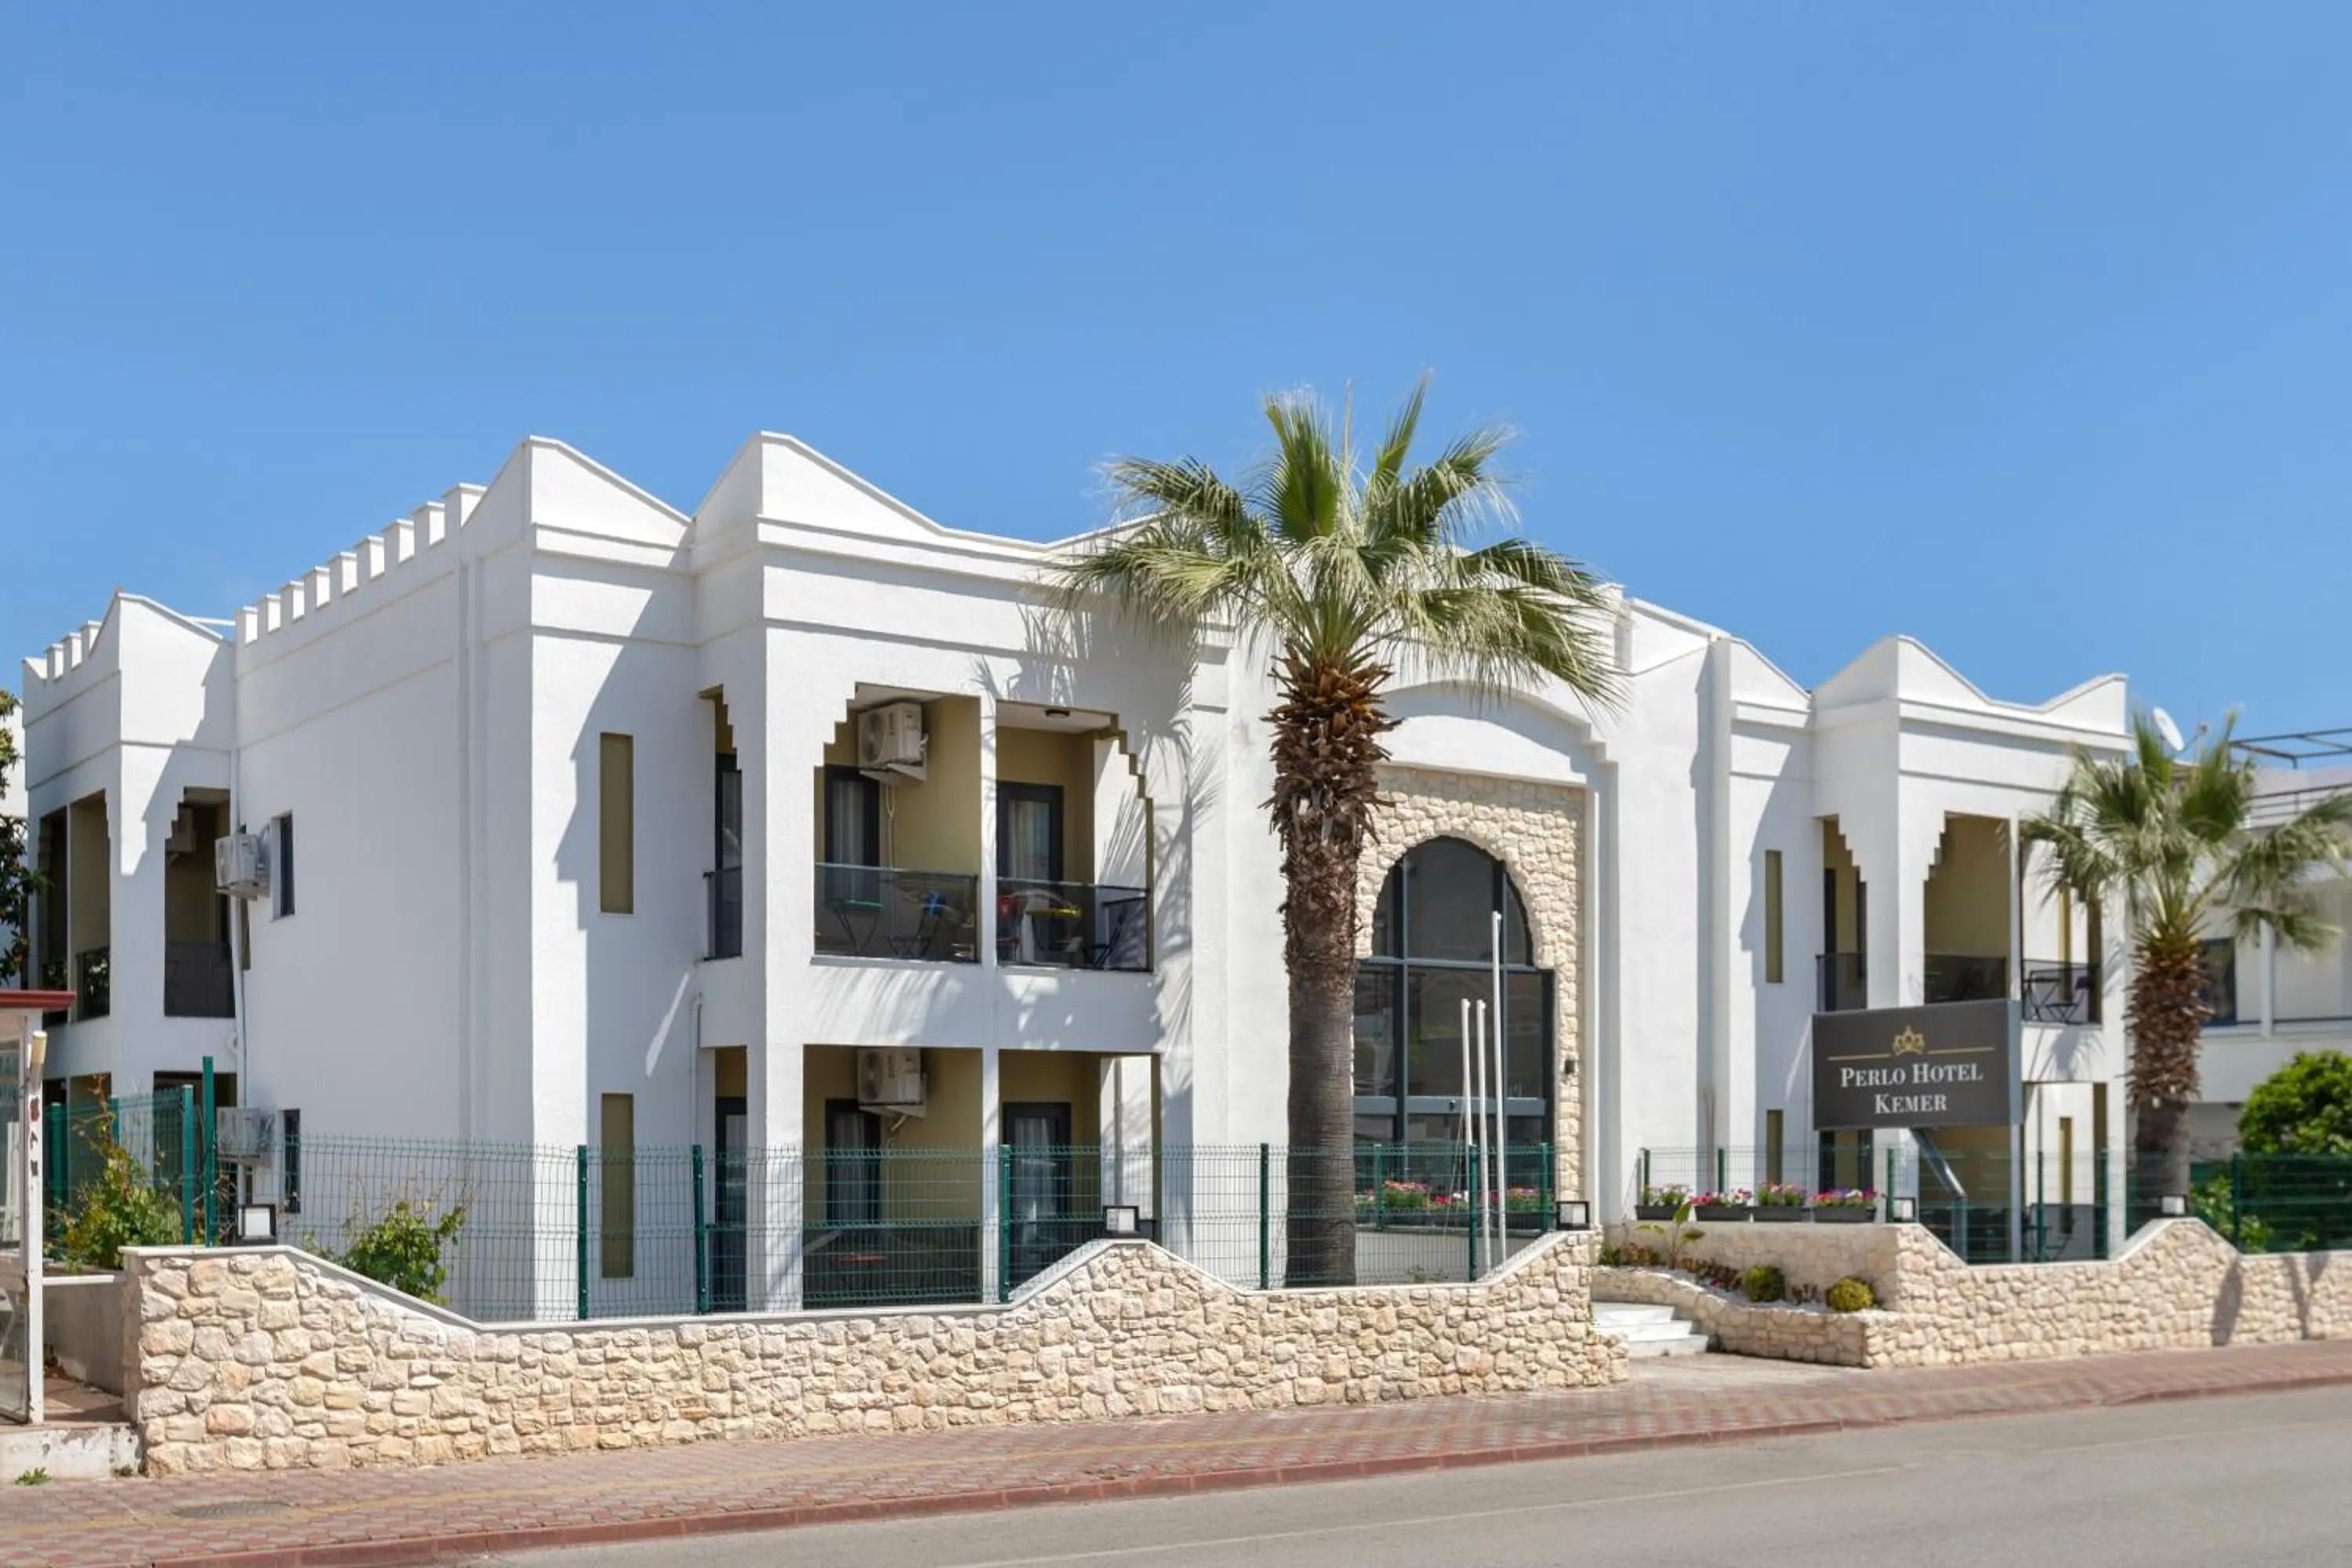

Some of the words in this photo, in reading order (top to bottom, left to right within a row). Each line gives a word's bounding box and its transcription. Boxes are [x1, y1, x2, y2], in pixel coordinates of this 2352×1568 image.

[1840, 1067, 1906, 1088] PERLO
[1912, 1063, 1984, 1083] HOTEL
[1874, 1094, 1947, 1114] KEMER
